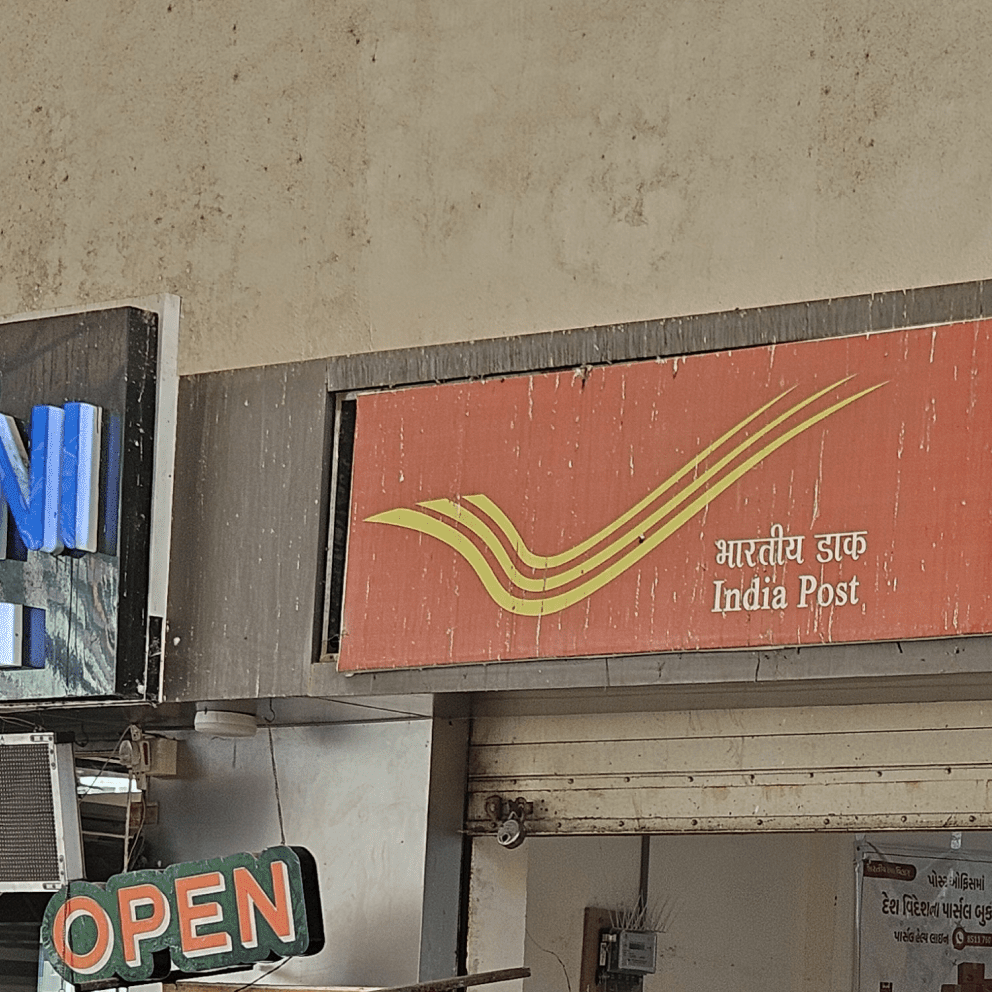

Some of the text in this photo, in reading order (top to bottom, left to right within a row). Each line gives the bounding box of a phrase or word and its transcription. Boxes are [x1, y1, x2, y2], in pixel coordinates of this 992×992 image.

[714, 523, 868, 569] भारतीय डाक
[711, 575, 859, 613] India Post
[52, 861, 295, 974] OPEN
[881, 891, 899, 915] દેશ
[902, 894, 939, 917] વિદેશના
[942, 897, 971, 919] પાર્સલ
[974, 904, 992, 926] બુક
